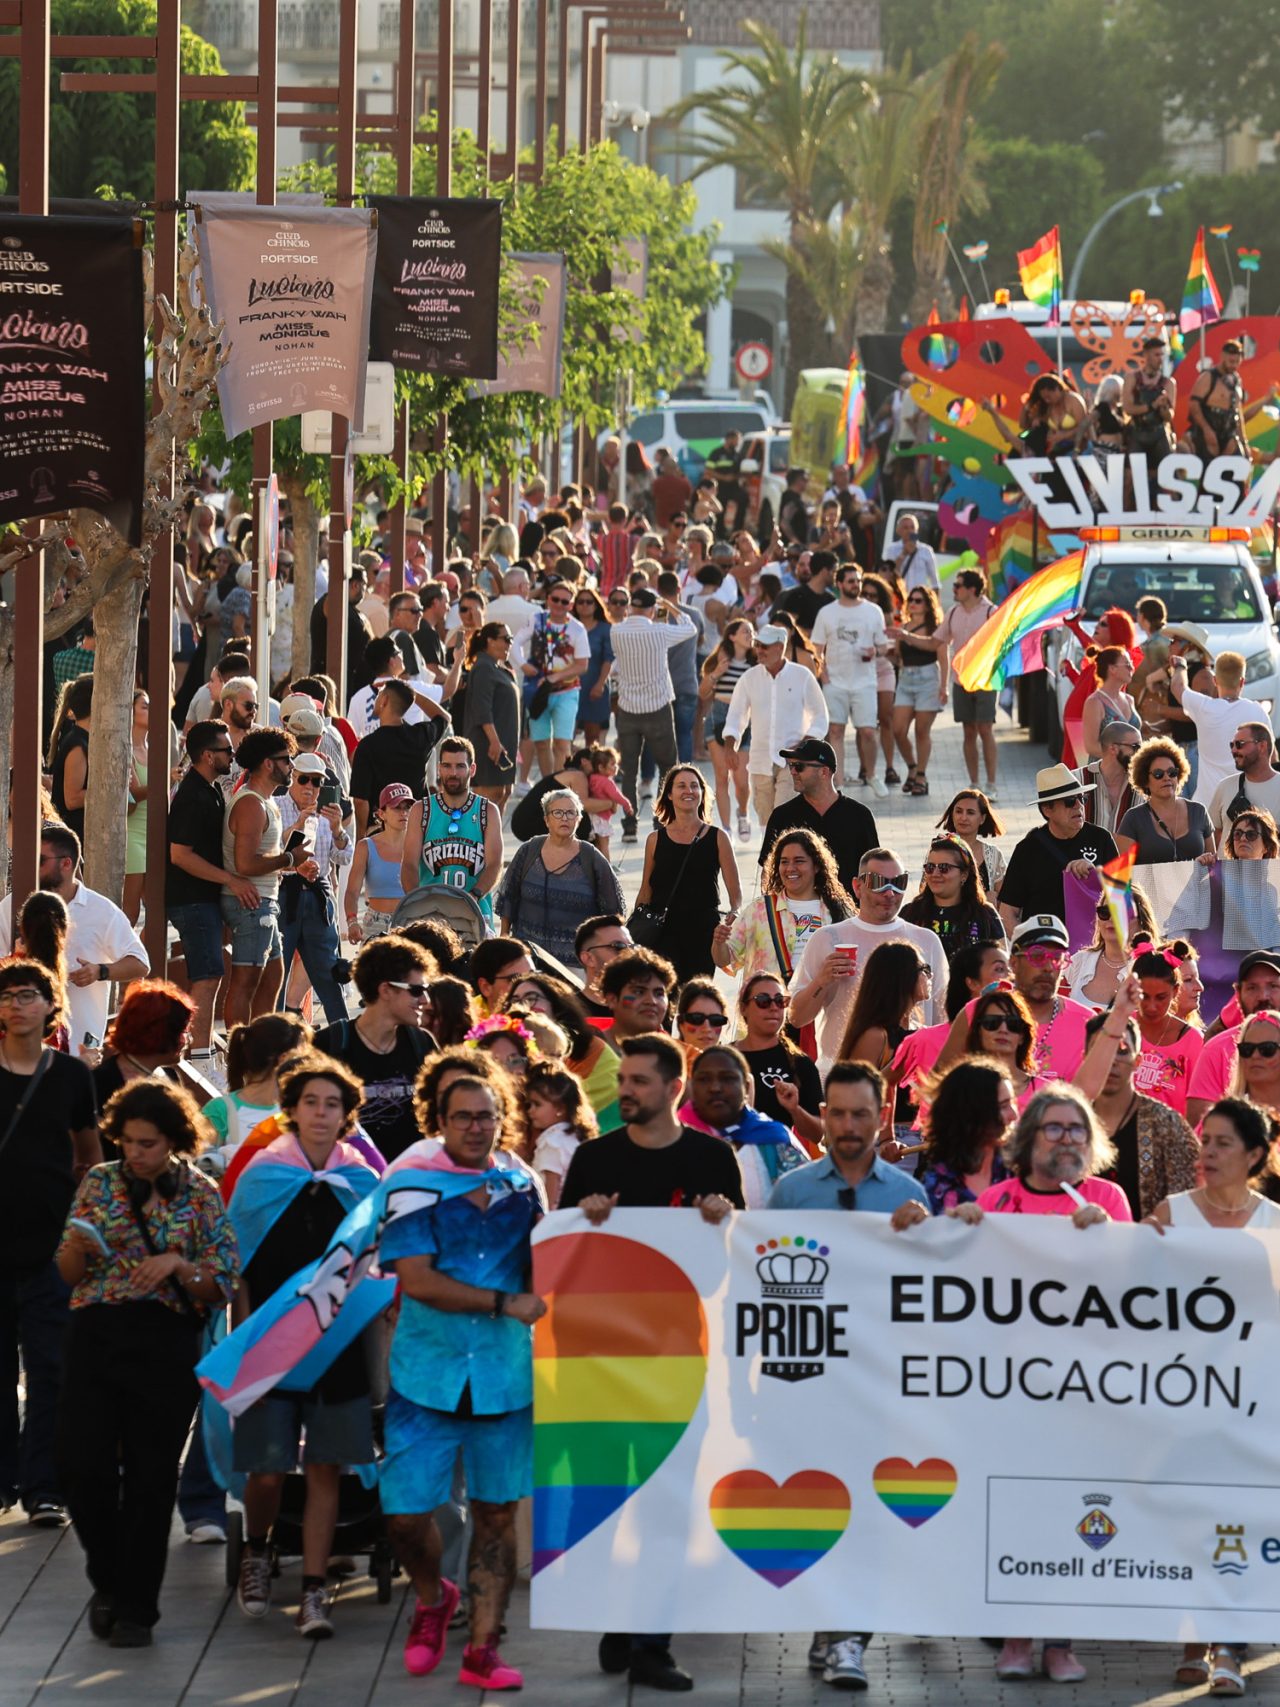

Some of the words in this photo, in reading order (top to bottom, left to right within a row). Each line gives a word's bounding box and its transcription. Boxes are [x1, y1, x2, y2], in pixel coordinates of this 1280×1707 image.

[275, 232, 301, 240] CLUB
[266, 239, 310, 248] CHINOIS
[412, 239, 456, 249] PORTSIDE
[260, 255, 319, 264] PORTSIDE
[0, 261, 50, 272] HINOIS
[0, 282, 64, 295] RTSIDE
[447, 288, 475, 297] WAH
[239, 310, 307, 325] FRANKY
[308, 310, 347, 322] WAH
[0, 309, 89, 349] ciano
[275, 323, 314, 331] MISS
[259, 330, 330, 342] MONIQUE
[275, 342, 315, 351] NOHAN
[0, 362, 50, 373] NKY
[4, 380, 62, 392] MISS
[0, 391, 86, 404] ONIQUE
[4, 408, 64, 421] NOHAN
[1131, 529, 1194, 539] GRUA
[389, 787, 412, 798] IBIZ
[422, 840, 486, 877] GRIZZLIES
[443, 869, 467, 890] 10
[890, 1275, 1254, 1341] EDUCACIÓ,
[736, 1303, 849, 1358] PRIDE
[766, 1364, 820, 1374] IBIZA
[900, 1352, 1260, 1417] EDUCACIÓN,
[998, 1555, 1084, 1578] Consell
[1091, 1557, 1193, 1581] d'Eivissa
